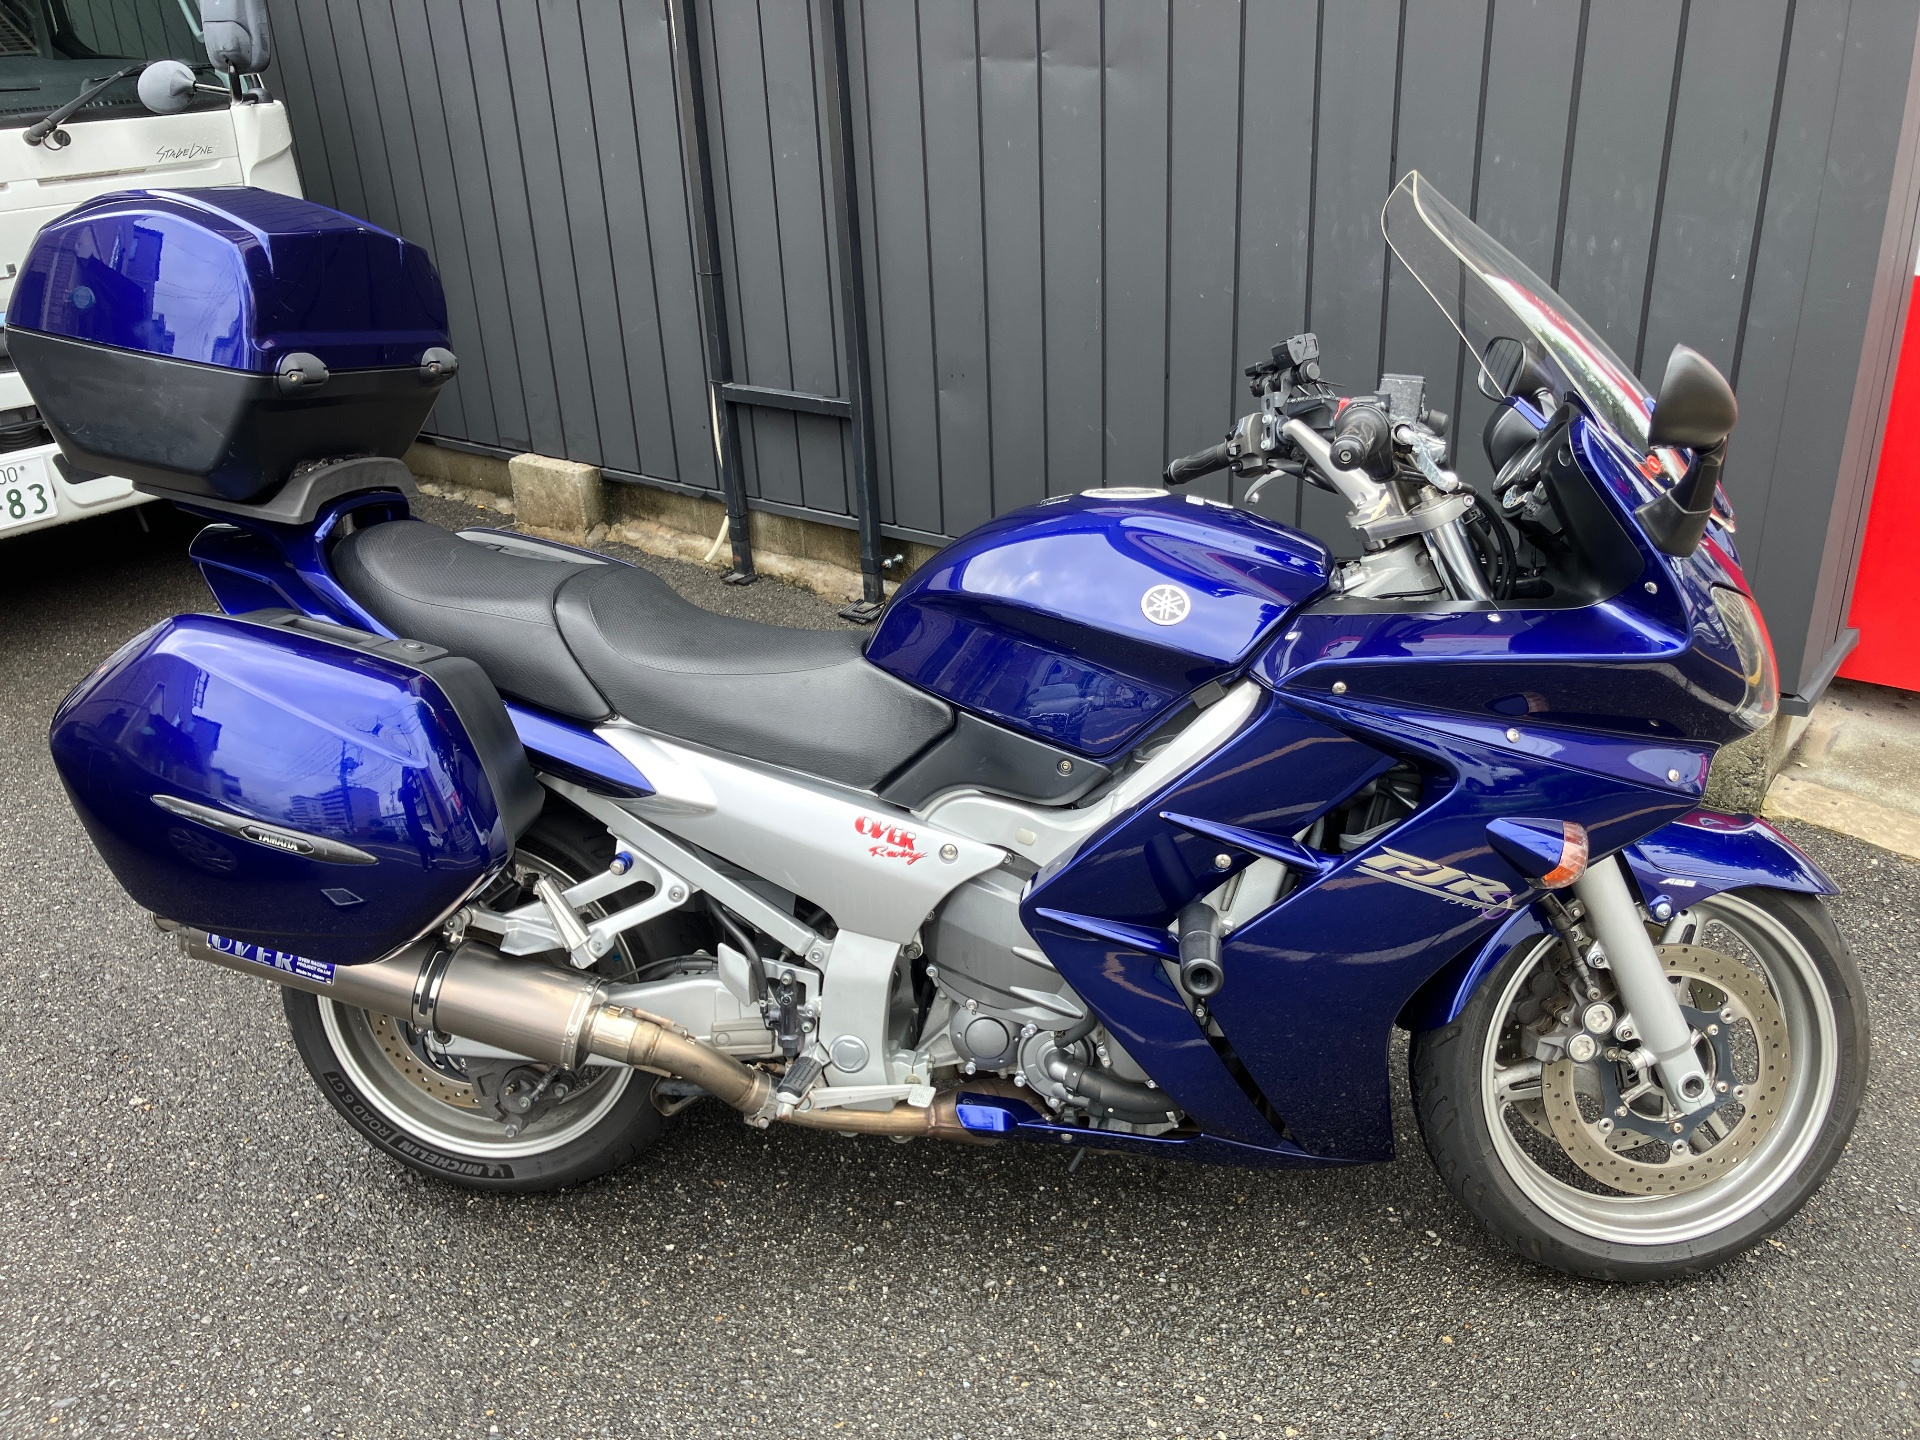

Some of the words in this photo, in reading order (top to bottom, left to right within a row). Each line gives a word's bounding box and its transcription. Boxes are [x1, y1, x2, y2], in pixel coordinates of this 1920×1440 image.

[258, 833, 298, 851] YAMAHA
[855, 815, 917, 851] OVER
[868, 845, 928, 866] Racing
[1361, 845, 1512, 904] FJR
[1659, 877, 1697, 888] ABS
[328, 1074, 346, 1093] GT
[341, 1092, 354, 1103] 6
[353, 1104, 391, 1139] ROAD
[397, 1139, 484, 1177] MICHELIN
